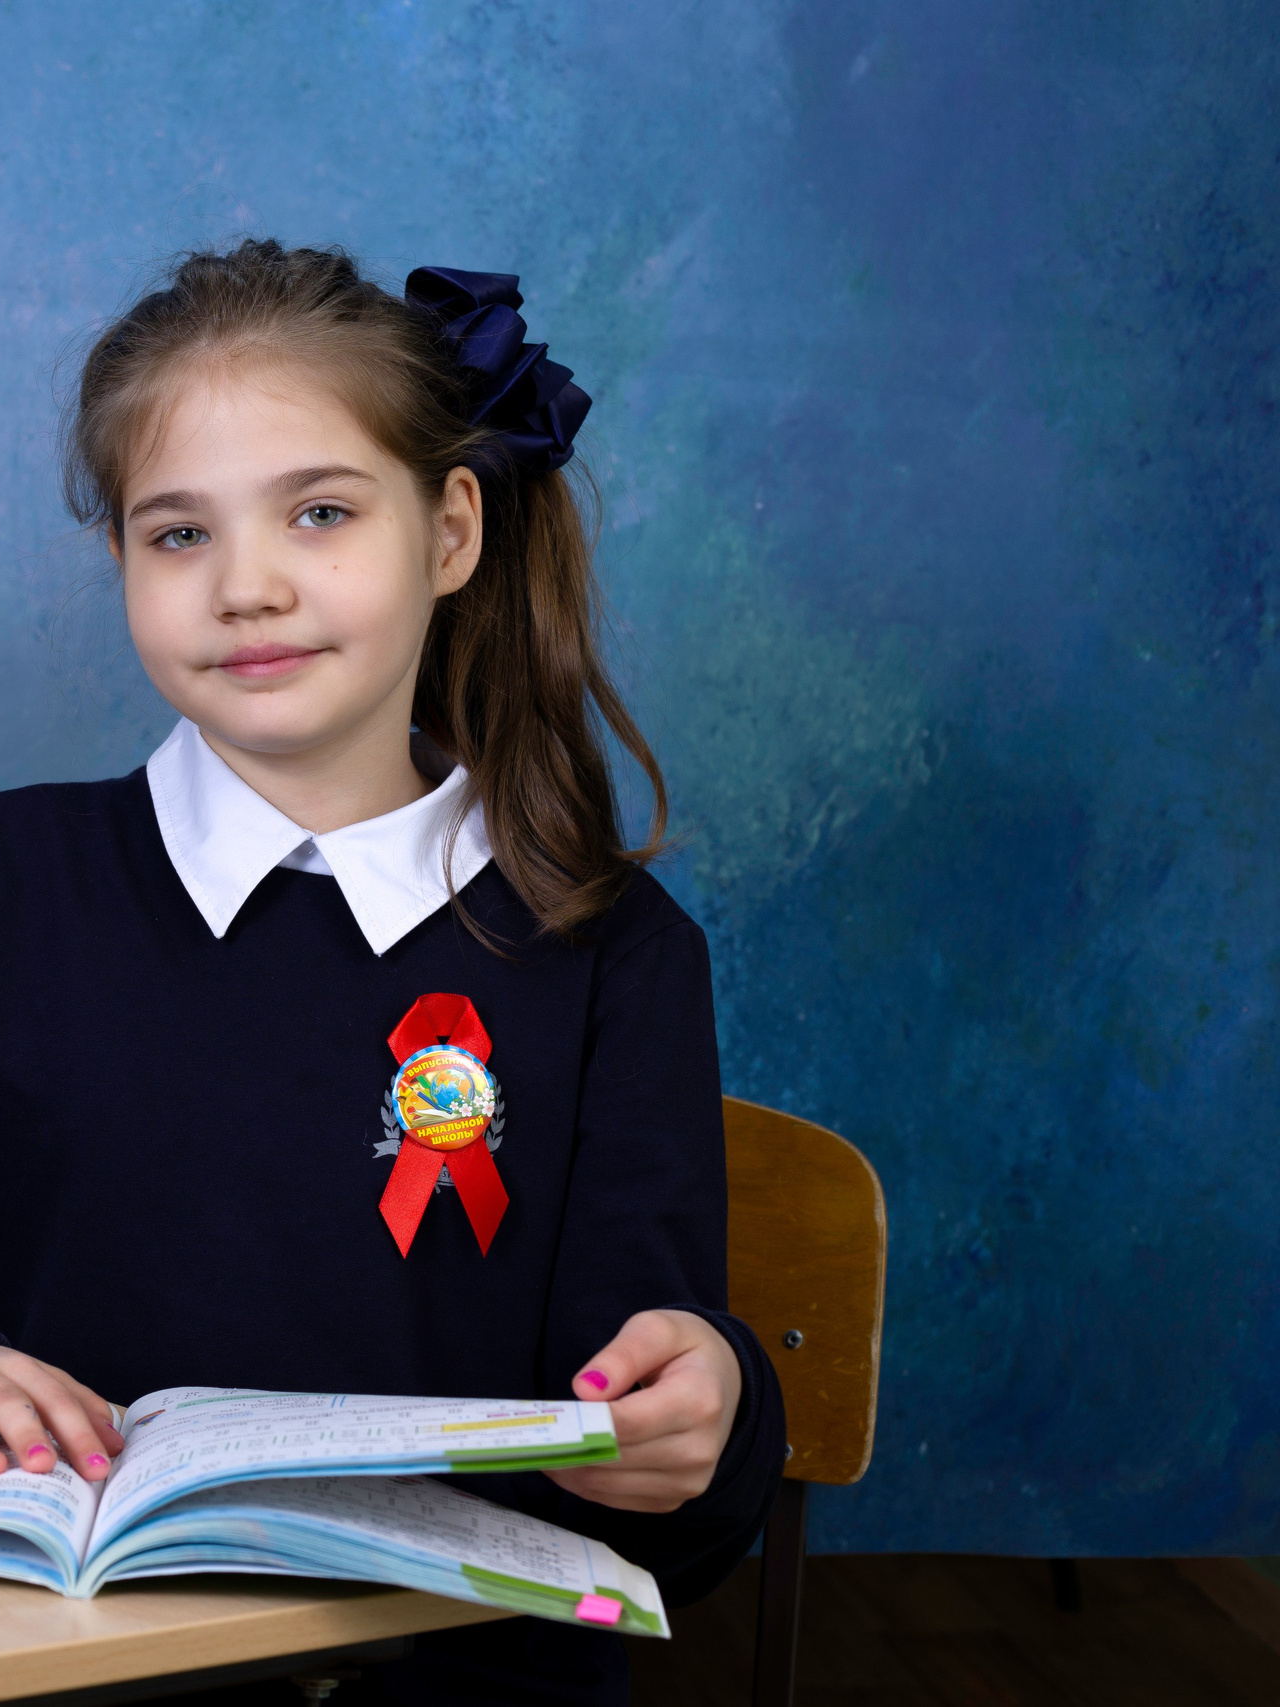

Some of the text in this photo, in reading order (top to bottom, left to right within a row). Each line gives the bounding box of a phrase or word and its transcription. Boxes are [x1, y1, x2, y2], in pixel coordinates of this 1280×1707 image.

[406, 1057, 473, 1078] ВЫПУСКНИ
[417, 1115, 484, 1138] НАЧАЛЬНОЙ
[431, 1129, 473, 1145] ШКОЛЫ
